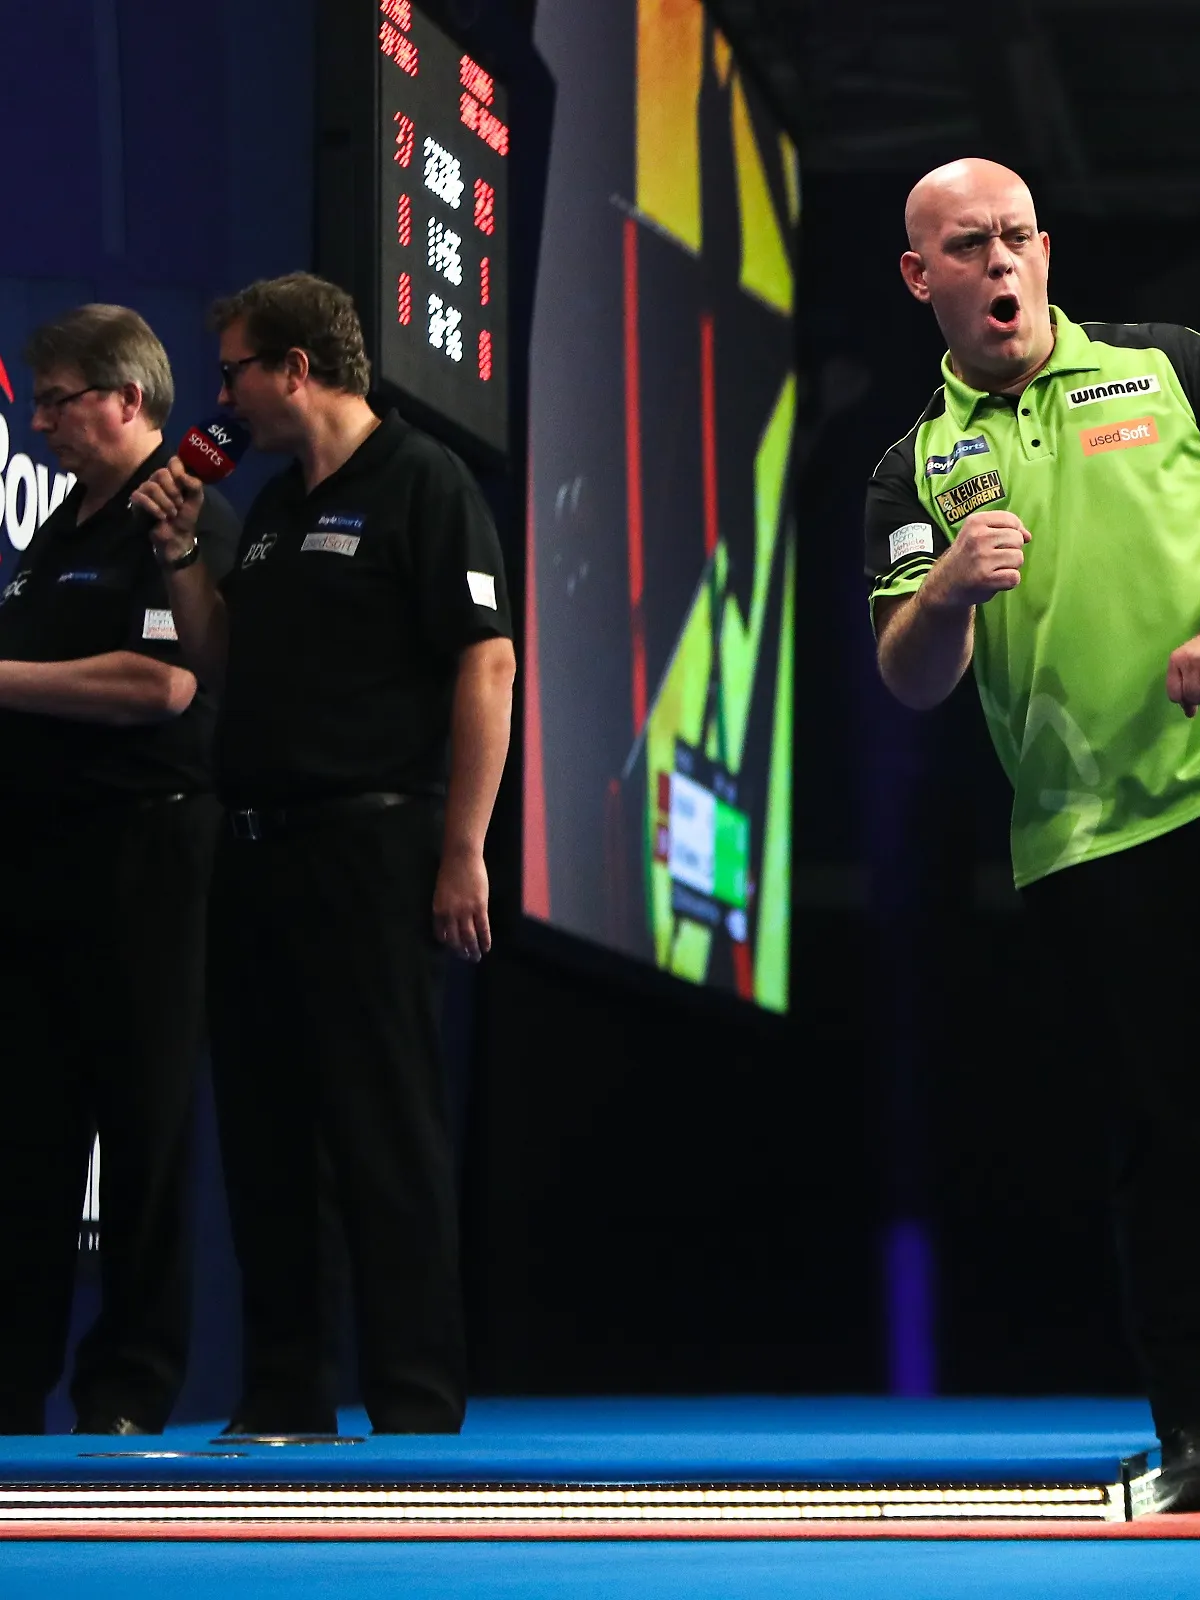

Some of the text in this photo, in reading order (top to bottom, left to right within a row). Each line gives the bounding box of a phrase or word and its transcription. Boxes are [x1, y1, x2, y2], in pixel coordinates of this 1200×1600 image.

[1070, 379, 1151, 404] WINMAU
[207, 424, 233, 446] sky
[1088, 424, 1151, 447] usedSoft
[188, 433, 224, 467] sports
[949, 472, 999, 506] KEUKEN
[946, 486, 1001, 522] CONCURRENT
[892, 524, 927, 539] money
[894, 538, 925, 554] vehicle
